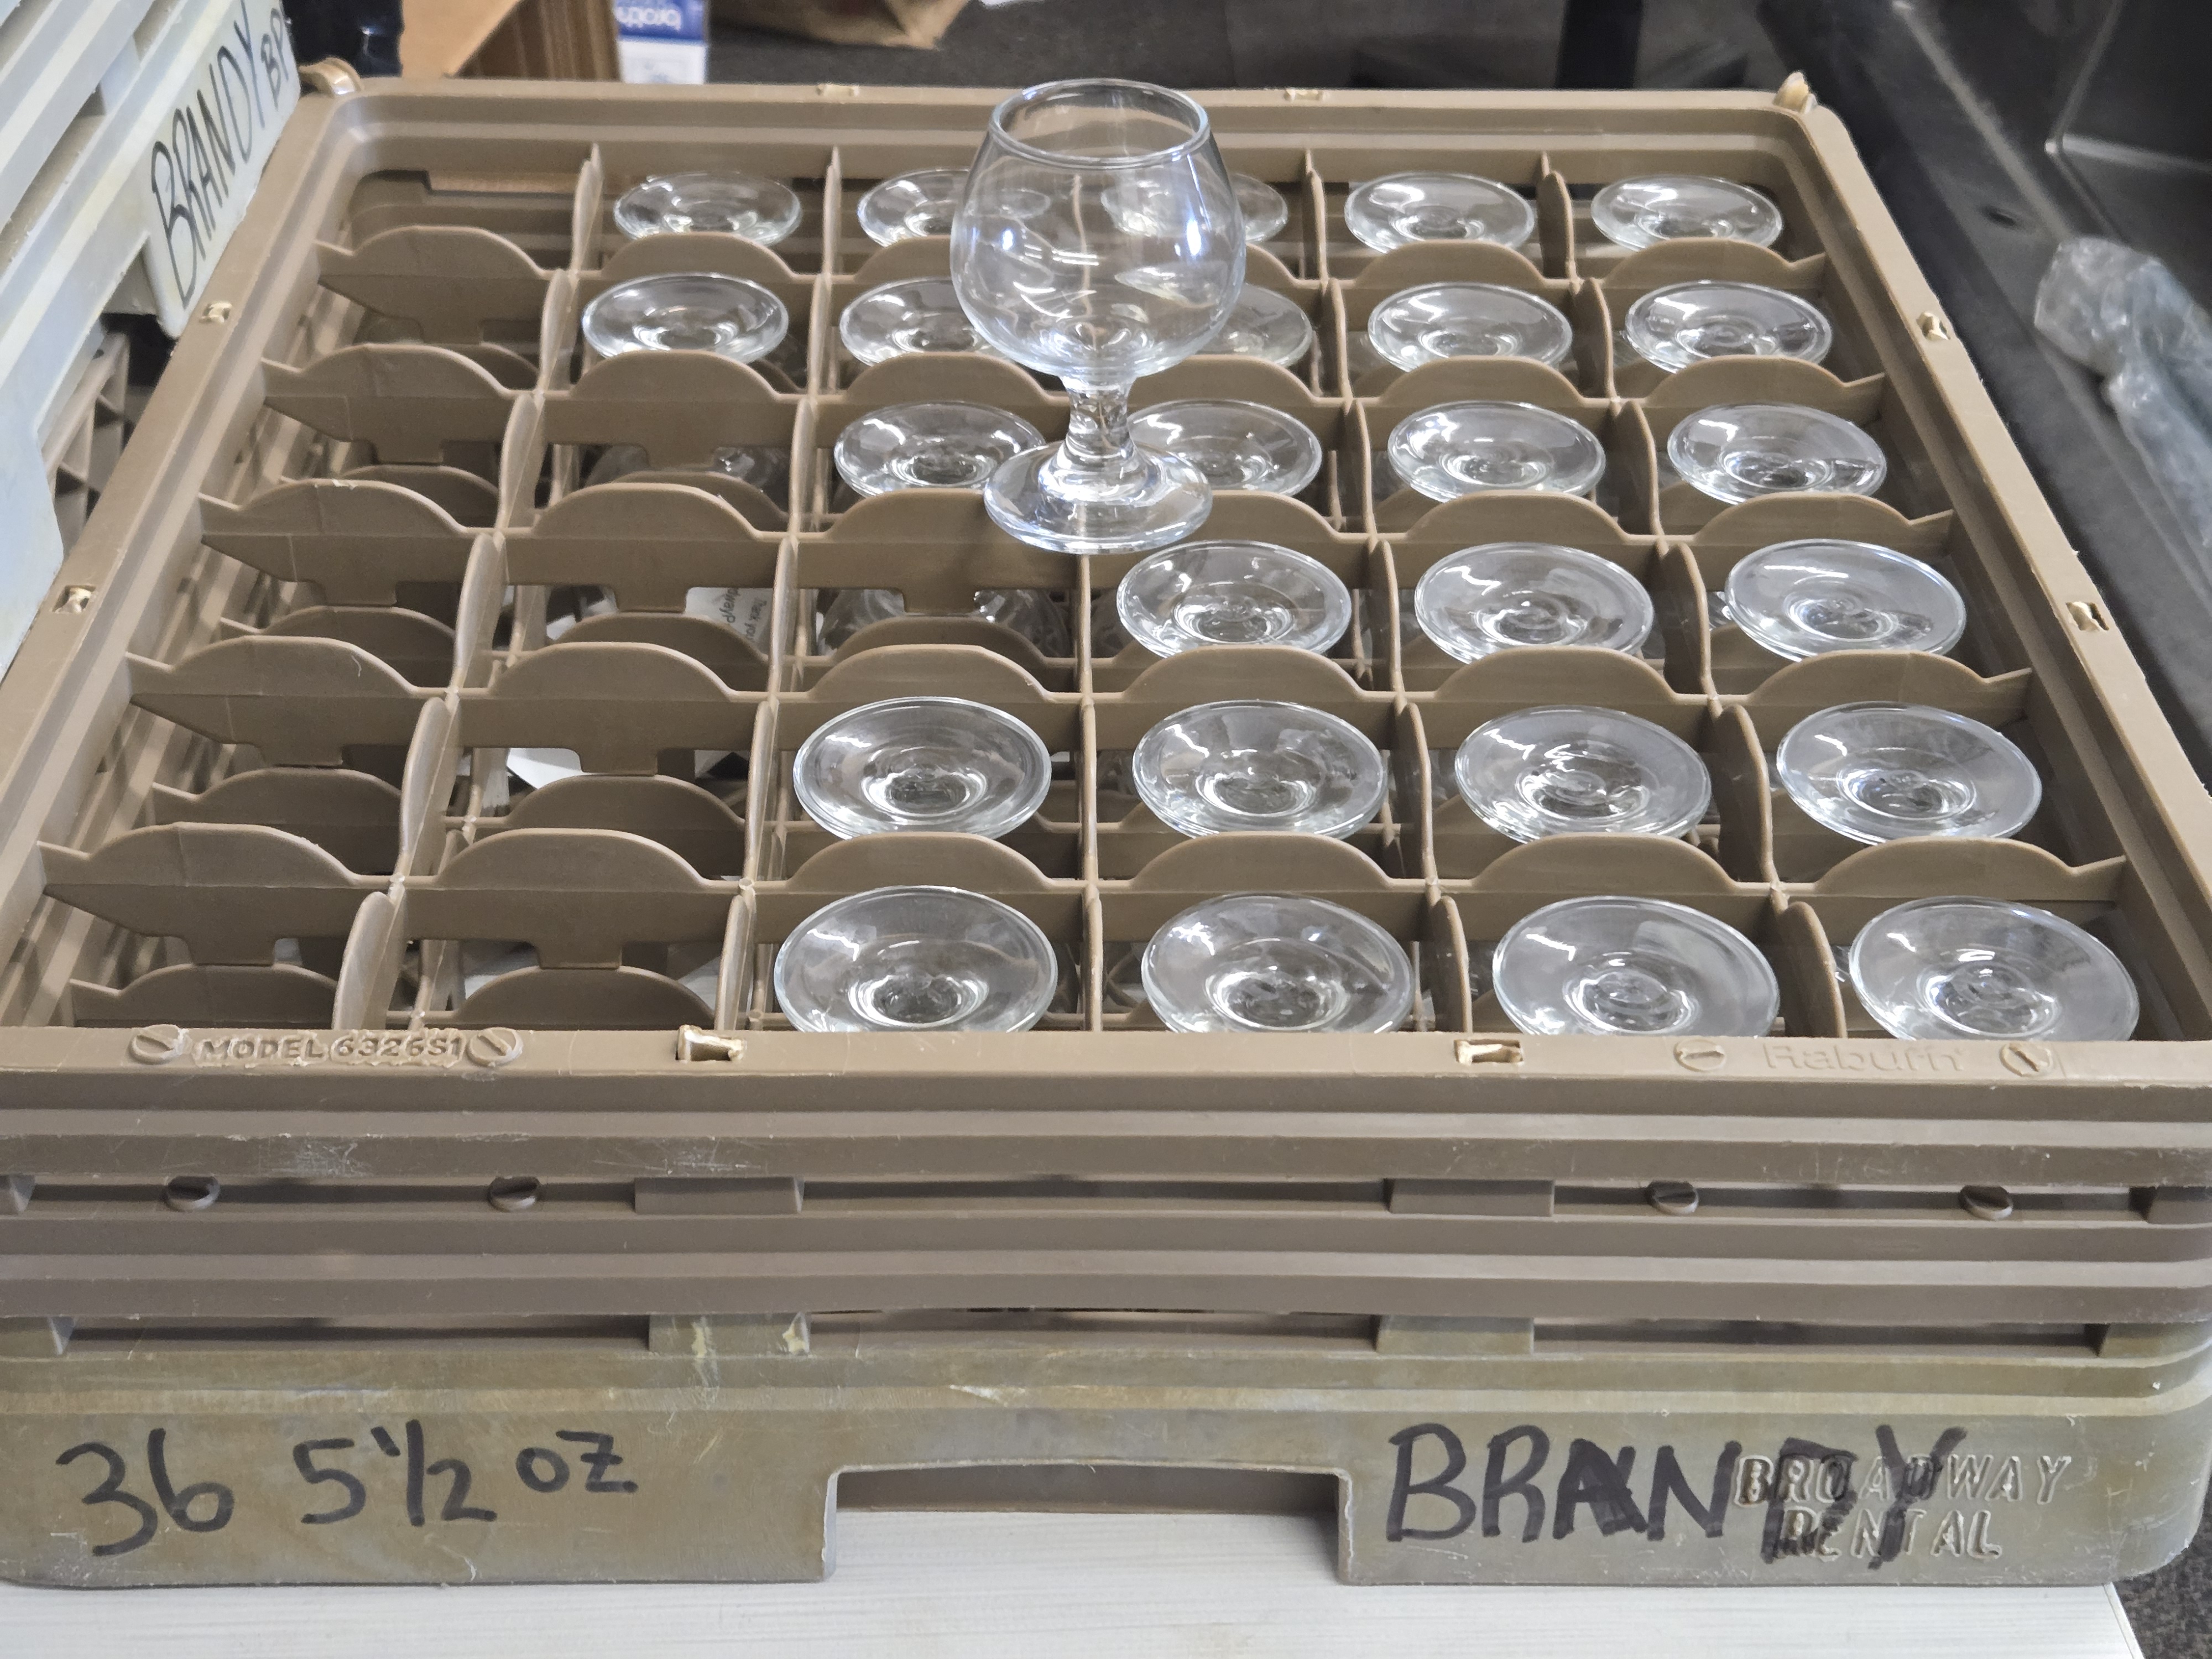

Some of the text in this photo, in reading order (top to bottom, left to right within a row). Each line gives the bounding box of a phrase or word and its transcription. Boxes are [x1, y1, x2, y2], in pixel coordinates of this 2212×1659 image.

[151, 0, 265, 310] BRANDY
[199, 1033, 327, 1061] MODEL
[56, 1427, 234, 1557] 36
[1386, 1423, 1967, 1569] BRANDY
[1733, 1454, 2073, 1507] BROADWAY
